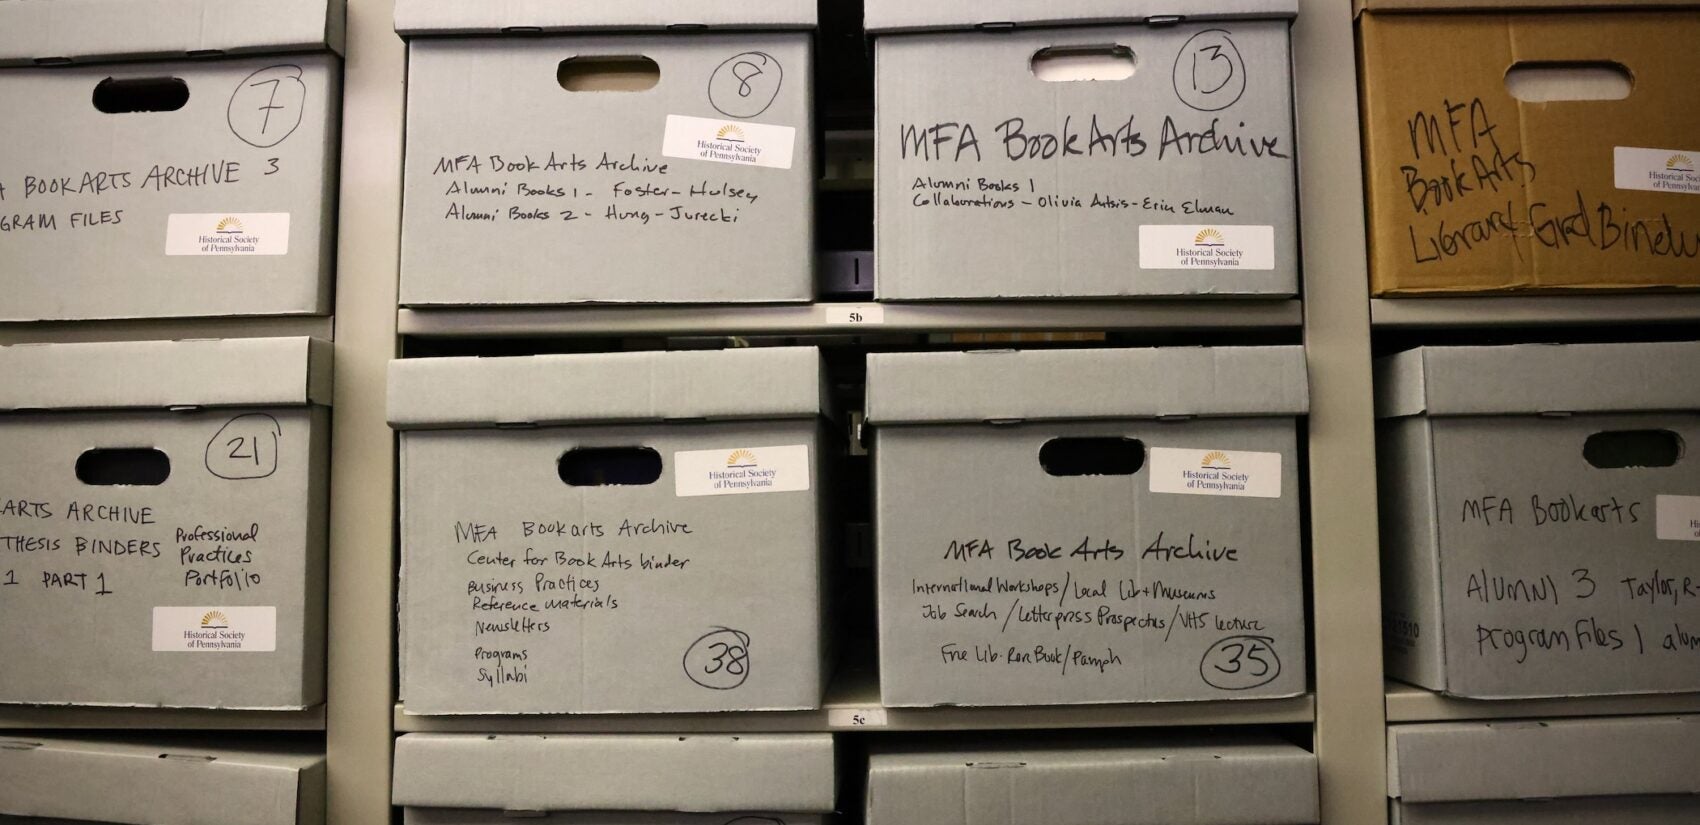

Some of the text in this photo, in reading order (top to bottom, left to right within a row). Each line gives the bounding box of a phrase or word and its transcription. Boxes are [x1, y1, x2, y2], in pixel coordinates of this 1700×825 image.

[732, 61, 764, 97] 8
[1192, 45, 1234, 94] 13
[250, 79, 285, 134] 7
[901, 115, 1290, 161] MFA Book Arts Archive
[1408, 97, 1497, 160] MFA
[697, 139, 762, 157] Historical Society
[699, 149, 757, 163] of Pennsylvania
[140, 159, 240, 191] ARCHIVE
[263, 158, 280, 175] 3
[433, 152, 668, 175] MFA Book Arts Archive
[912, 177, 970, 191] Alumni
[978, 178, 1020, 192] Books
[1400, 151, 1536, 214] Book Arts
[1649, 171, 1684, 182] Historical
[1653, 181, 1661, 189] of
[446, 180, 507, 196] Alumni
[517, 183, 566, 197] Books
[445, 202, 499, 222] Alumni
[509, 206, 550, 220] Books
[560, 210, 578, 221] 2
[605, 204, 650, 224] Hung
[669, 205, 740, 223] Jurecki
[913, 193, 1014, 209] Collaborations
[1038, 195, 1082, 209] Olivia
[1182, 201, 1235, 216] Elman
[0, 210, 124, 232] GRAM FILES
[1409, 200, 1525, 263] Library
[198, 235, 259, 245] Historical Society
[201, 244, 255, 253] of Pennsylvania
[1176, 248, 1243, 259] Historical Society
[1180, 257, 1240, 268] of Pennsylvania
[849, 312, 863, 322] 5b
[227, 436, 259, 465] 21
[708, 468, 777, 480] Historical Society
[713, 477, 772, 489] of Pennsylvania
[1182, 470, 1249, 483] Historical Society
[1187, 480, 1246, 492] of Pennsylvania
[67, 501, 156, 524] ARCHIVE
[1462, 496, 1513, 526] MFA
[175, 523, 259, 544] Professional
[454, 521, 497, 543] MFA
[618, 518, 693, 537] Archive
[0, 536, 161, 558] THESIS BINDERS
[180, 546, 252, 565] Practices
[943, 531, 1238, 562] MFA Book Arts Archive
[467, 548, 690, 570] Center for Book Arts binder
[3, 569, 113, 595] 1 PART 1
[185, 568, 261, 591] Portfolio
[468, 572, 600, 595] Business Practices
[912, 576, 993, 595] International
[1571, 568, 1596, 599] 3
[472, 596, 540, 611] Reference
[922, 604, 946, 620] Job
[954, 602, 997, 620] Search
[183, 630, 246, 641] Historical Society
[475, 616, 550, 634] Newsletters
[187, 639, 242, 650] of Pennsylvania
[474, 647, 528, 669] Programs
[704, 643, 748, 676] 38
[1214, 643, 1269, 676] 35
[477, 665, 528, 688] Syllabi
[852, 714, 866, 725] 5c
